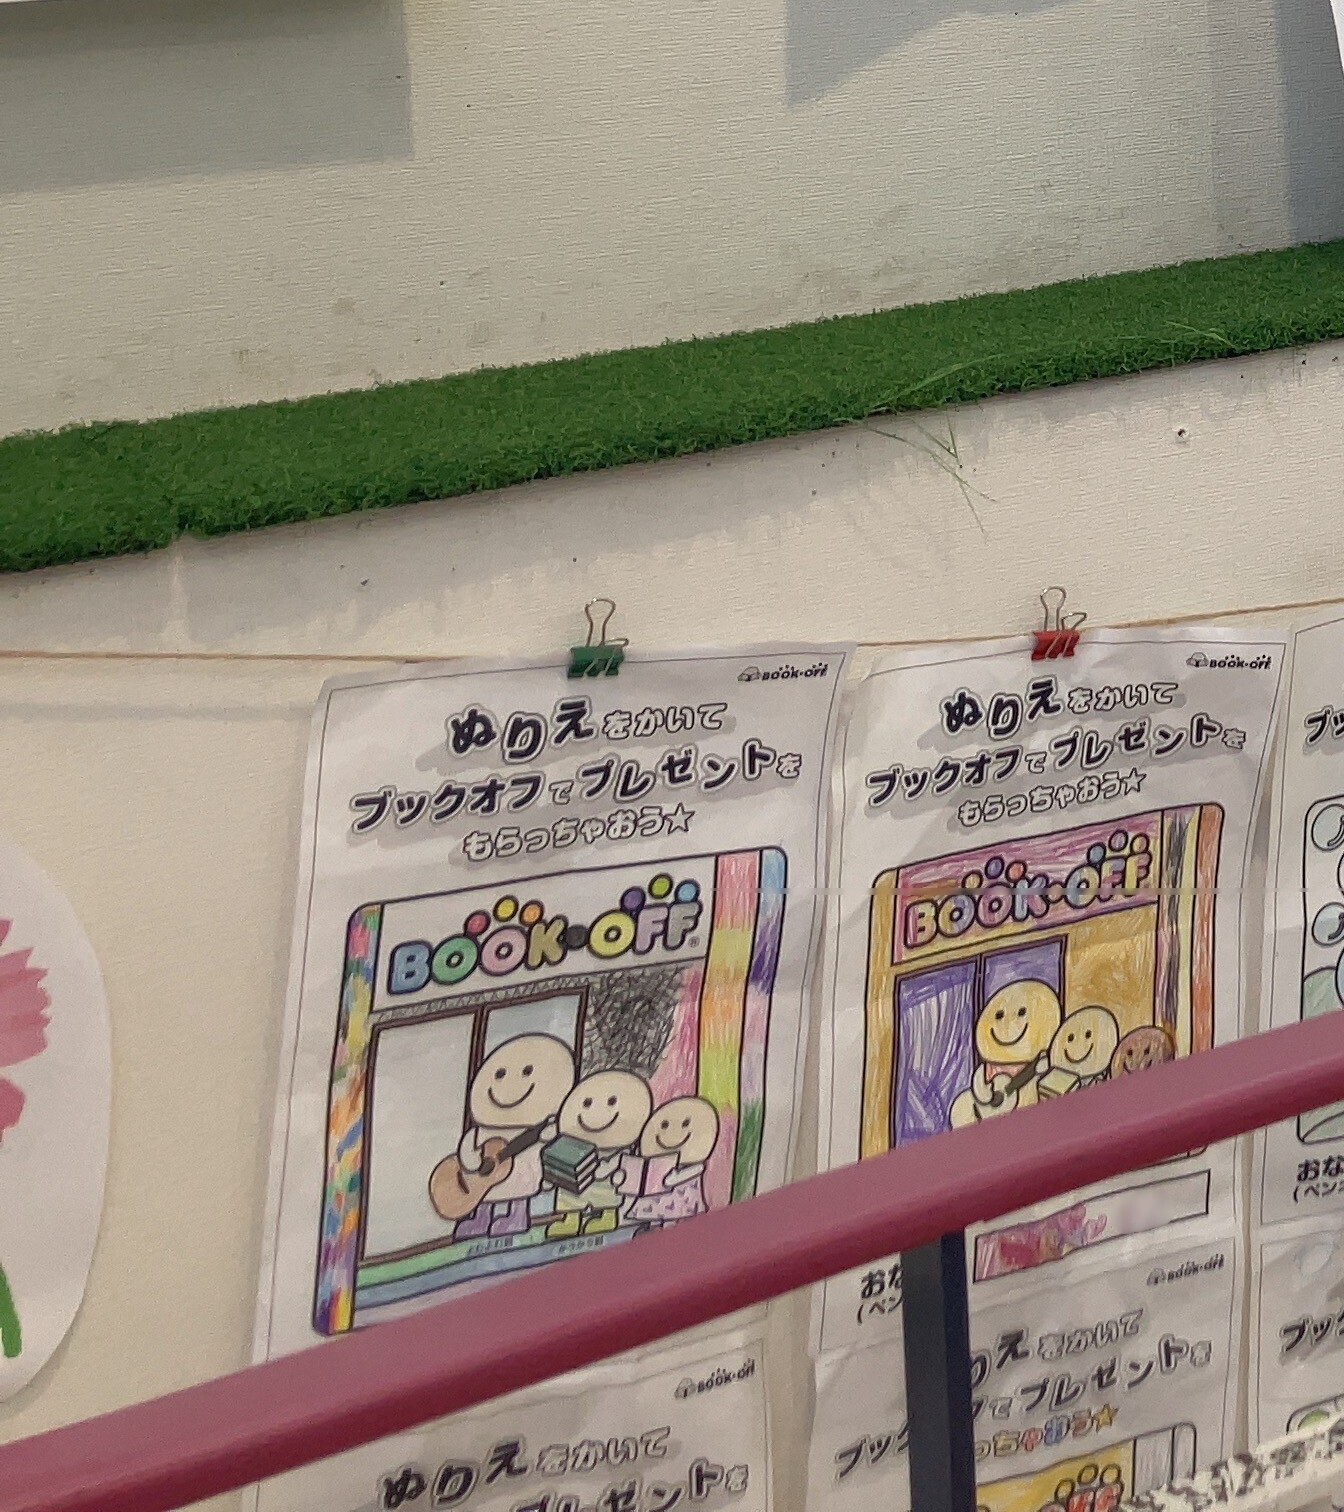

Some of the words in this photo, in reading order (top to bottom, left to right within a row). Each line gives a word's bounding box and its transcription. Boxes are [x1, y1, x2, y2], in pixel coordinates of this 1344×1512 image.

[448, 697, 728, 760] ぬりえをかいて
[942, 676, 1178, 736] ぬりえをかいて
[350, 738, 802, 832] ブックオフでプレゼントを
[866, 713, 1247, 807] ブックオフでプレゼントを
